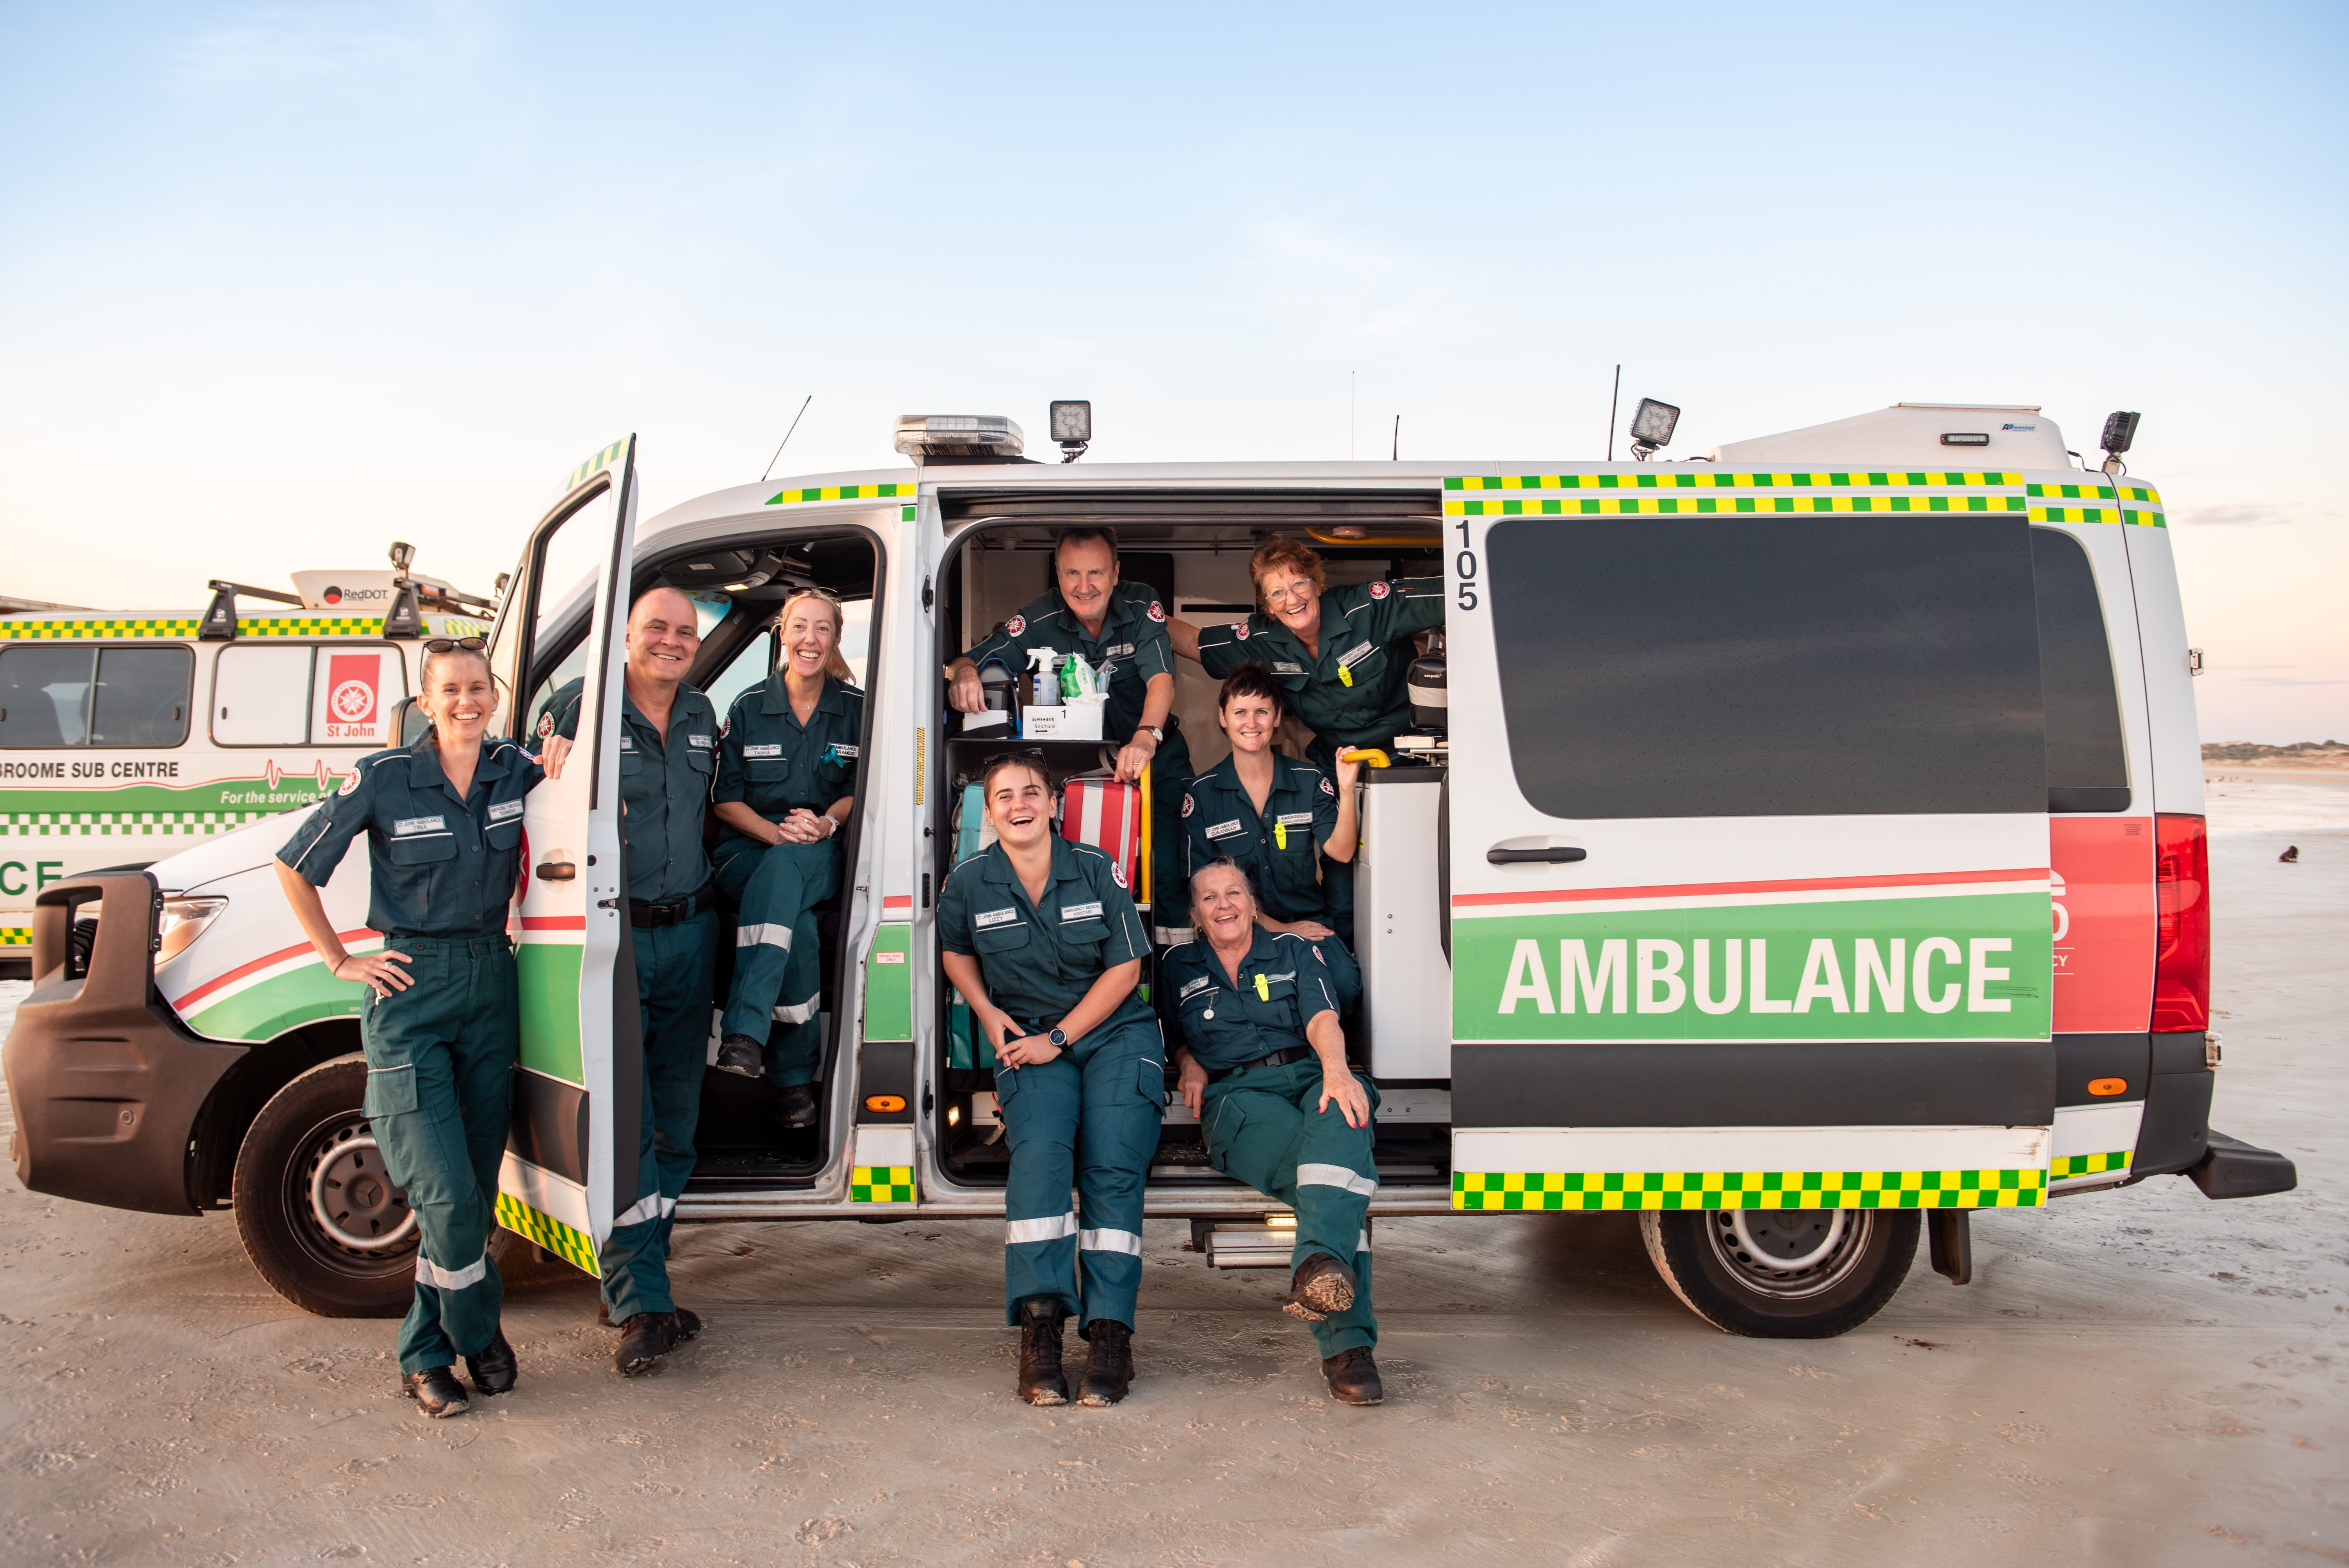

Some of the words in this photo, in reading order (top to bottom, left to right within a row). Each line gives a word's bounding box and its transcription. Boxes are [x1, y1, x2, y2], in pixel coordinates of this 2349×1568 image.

[344, 589, 388, 599] RedDOT
[1339, 650, 1356, 663] EMERGENCY
[1356, 643, 1369, 652] MEDICAL
[1062, 709, 1066, 718] 1
[327, 725, 340, 737] St
[344, 723, 374, 737] John
[71, 762, 104, 778] SUB
[111, 762, 178, 777] CENTRE
[221, 791, 243, 804] For
[245, 791, 266, 804] the
[268, 790, 315, 803] service
[1211, 826, 1237, 836] SUSANNAH
[1497, 936, 2012, 1014] AMBULANCE
